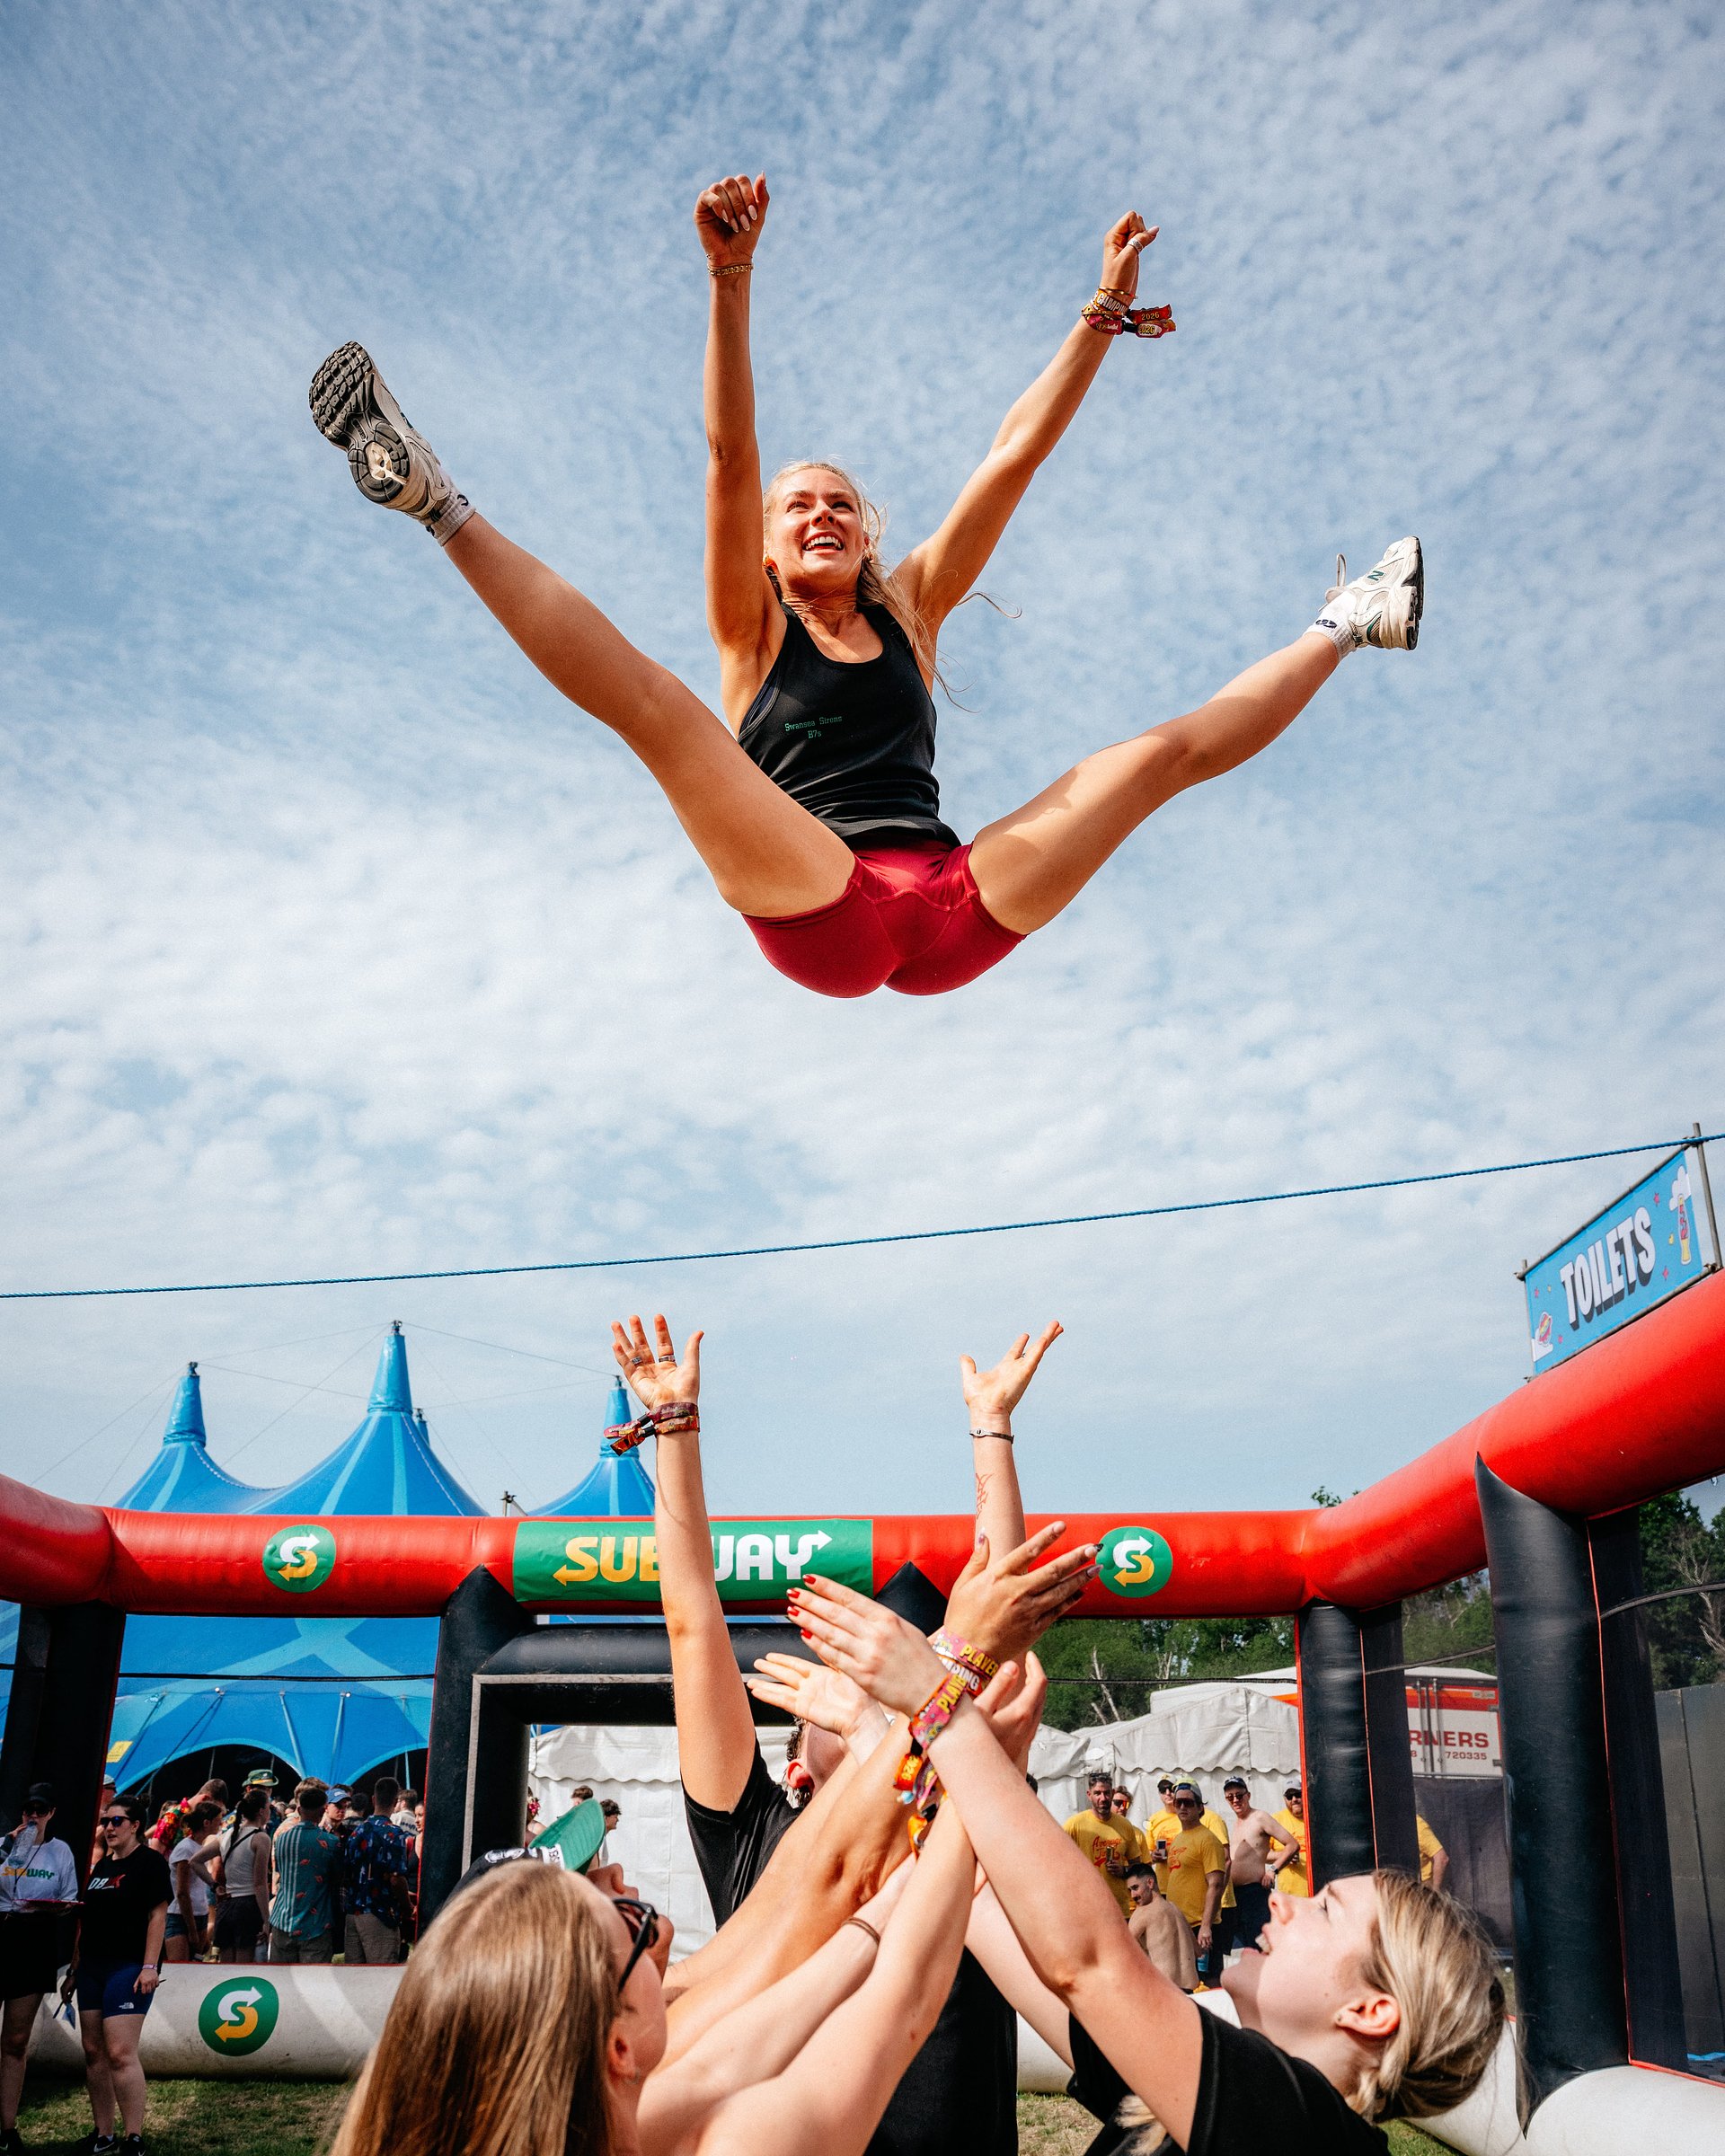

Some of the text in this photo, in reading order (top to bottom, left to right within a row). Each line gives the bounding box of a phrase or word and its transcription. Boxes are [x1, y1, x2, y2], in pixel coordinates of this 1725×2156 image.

[1141, 311, 1160, 321] 2026
[784, 716, 843, 731] Swansea Sirens
[807, 730, 822, 738] B7s
[1560, 1206, 1656, 1330] TOILETS
[1445, 1751, 1487, 1761] 720335
